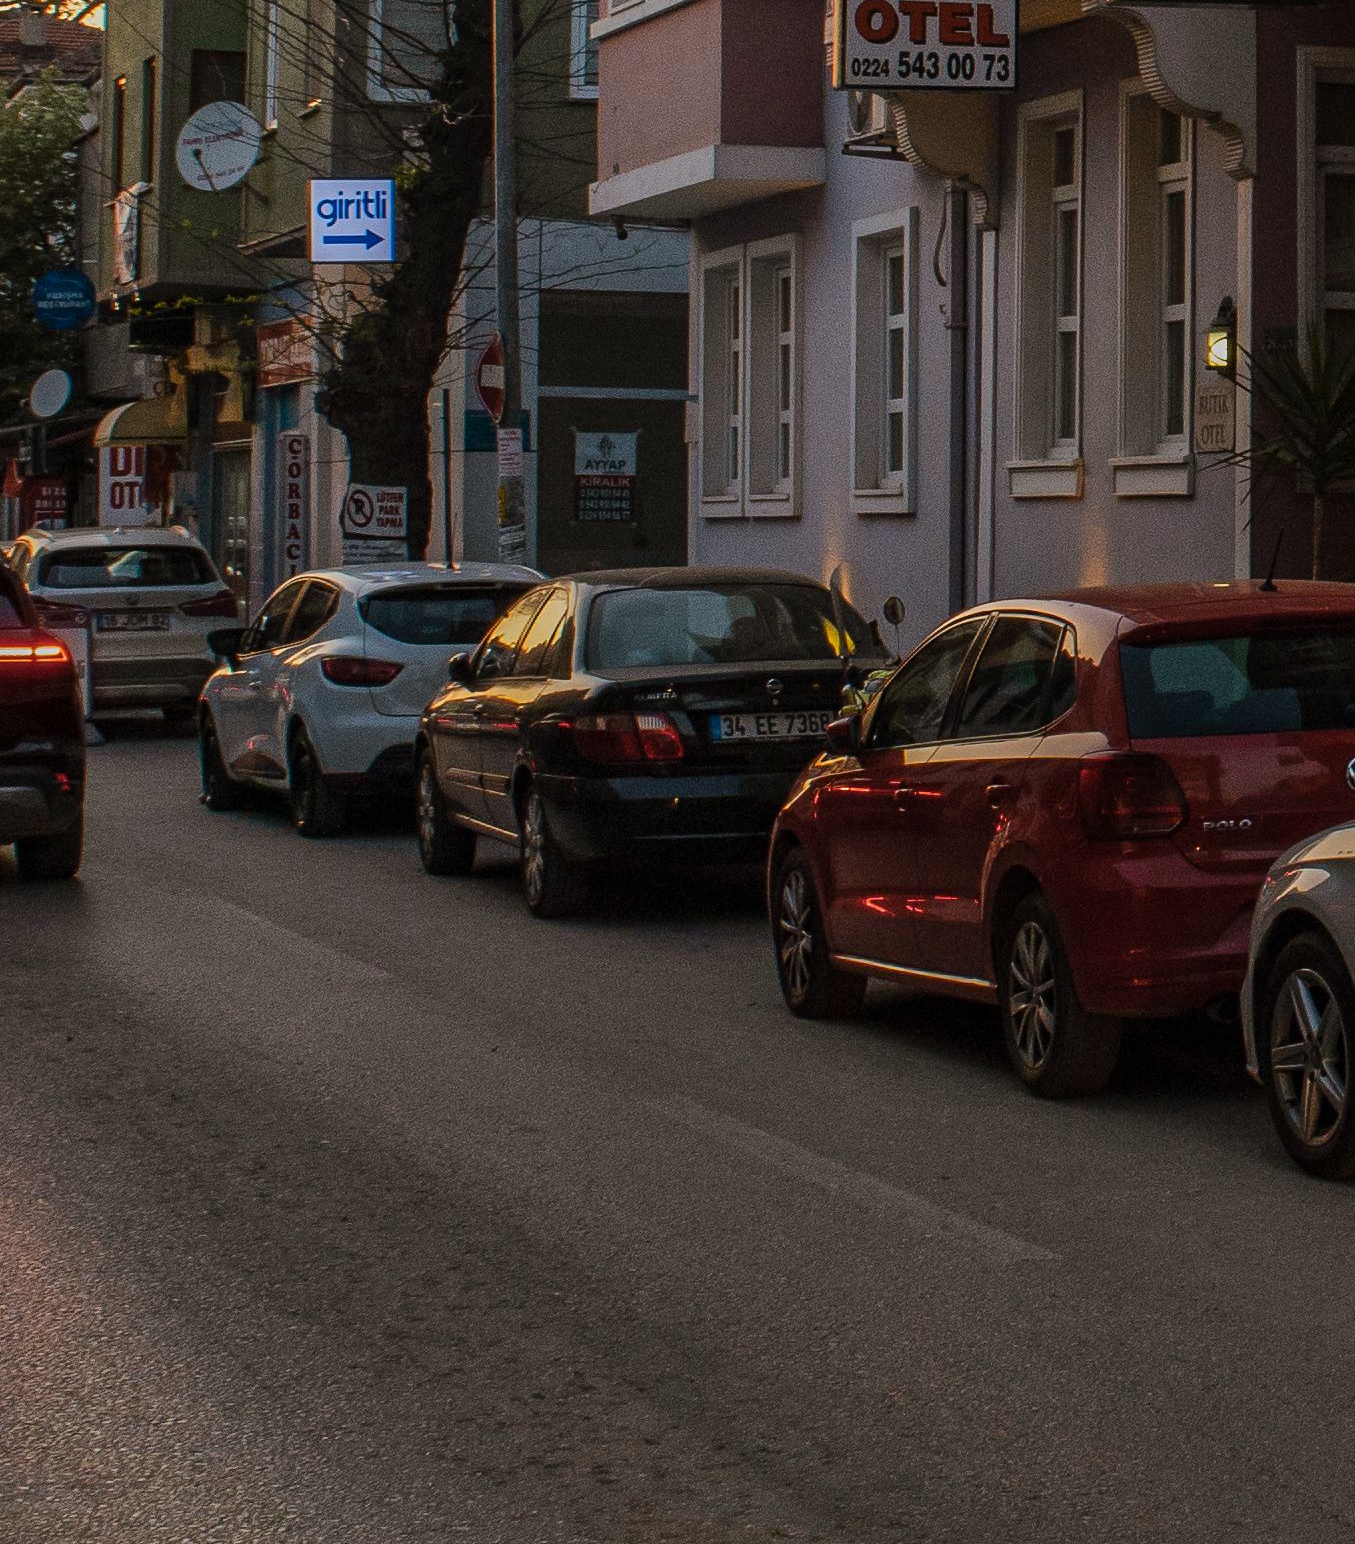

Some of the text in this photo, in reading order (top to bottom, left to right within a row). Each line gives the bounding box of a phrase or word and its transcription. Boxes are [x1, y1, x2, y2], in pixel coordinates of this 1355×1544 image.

[852, 50, 1010, 82] 0224 543 00 73
[316, 190, 388, 228] giritli
[378, 504, 401, 515] PARK
[723, 713, 830, 737] 34 EE 7368
[1202, 817, 1252, 832] POLO
